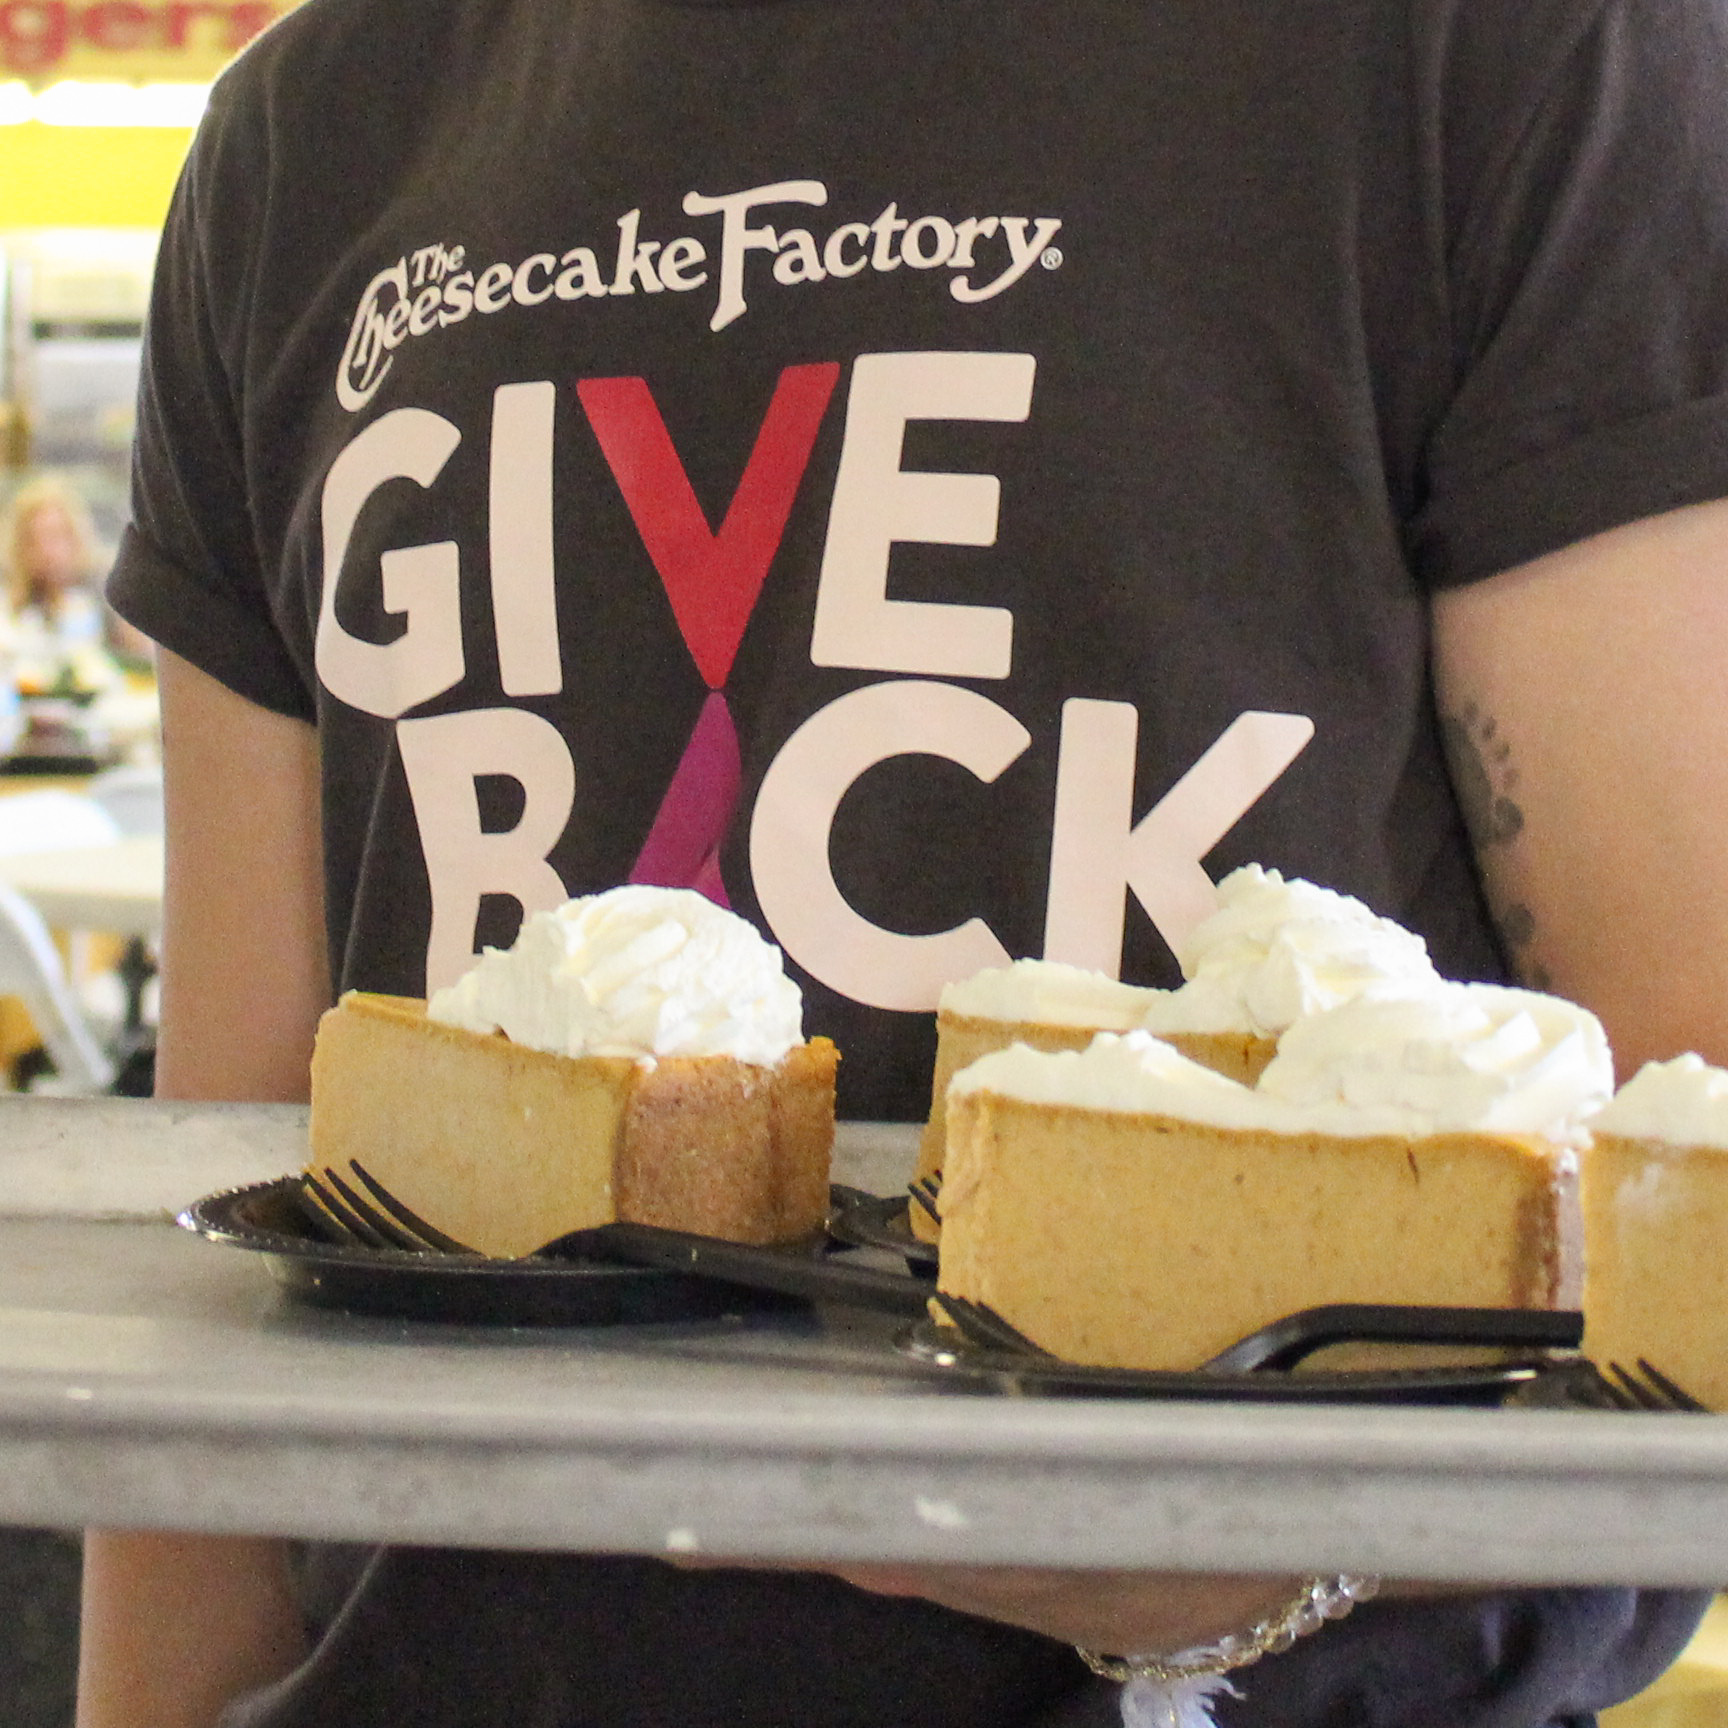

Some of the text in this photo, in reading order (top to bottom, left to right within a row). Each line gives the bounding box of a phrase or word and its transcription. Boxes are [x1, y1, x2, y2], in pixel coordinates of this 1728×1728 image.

[335, 207, 709, 413] Cheesecake
[410, 241, 467, 288] The
[315, 350, 1037, 719] GIVE
